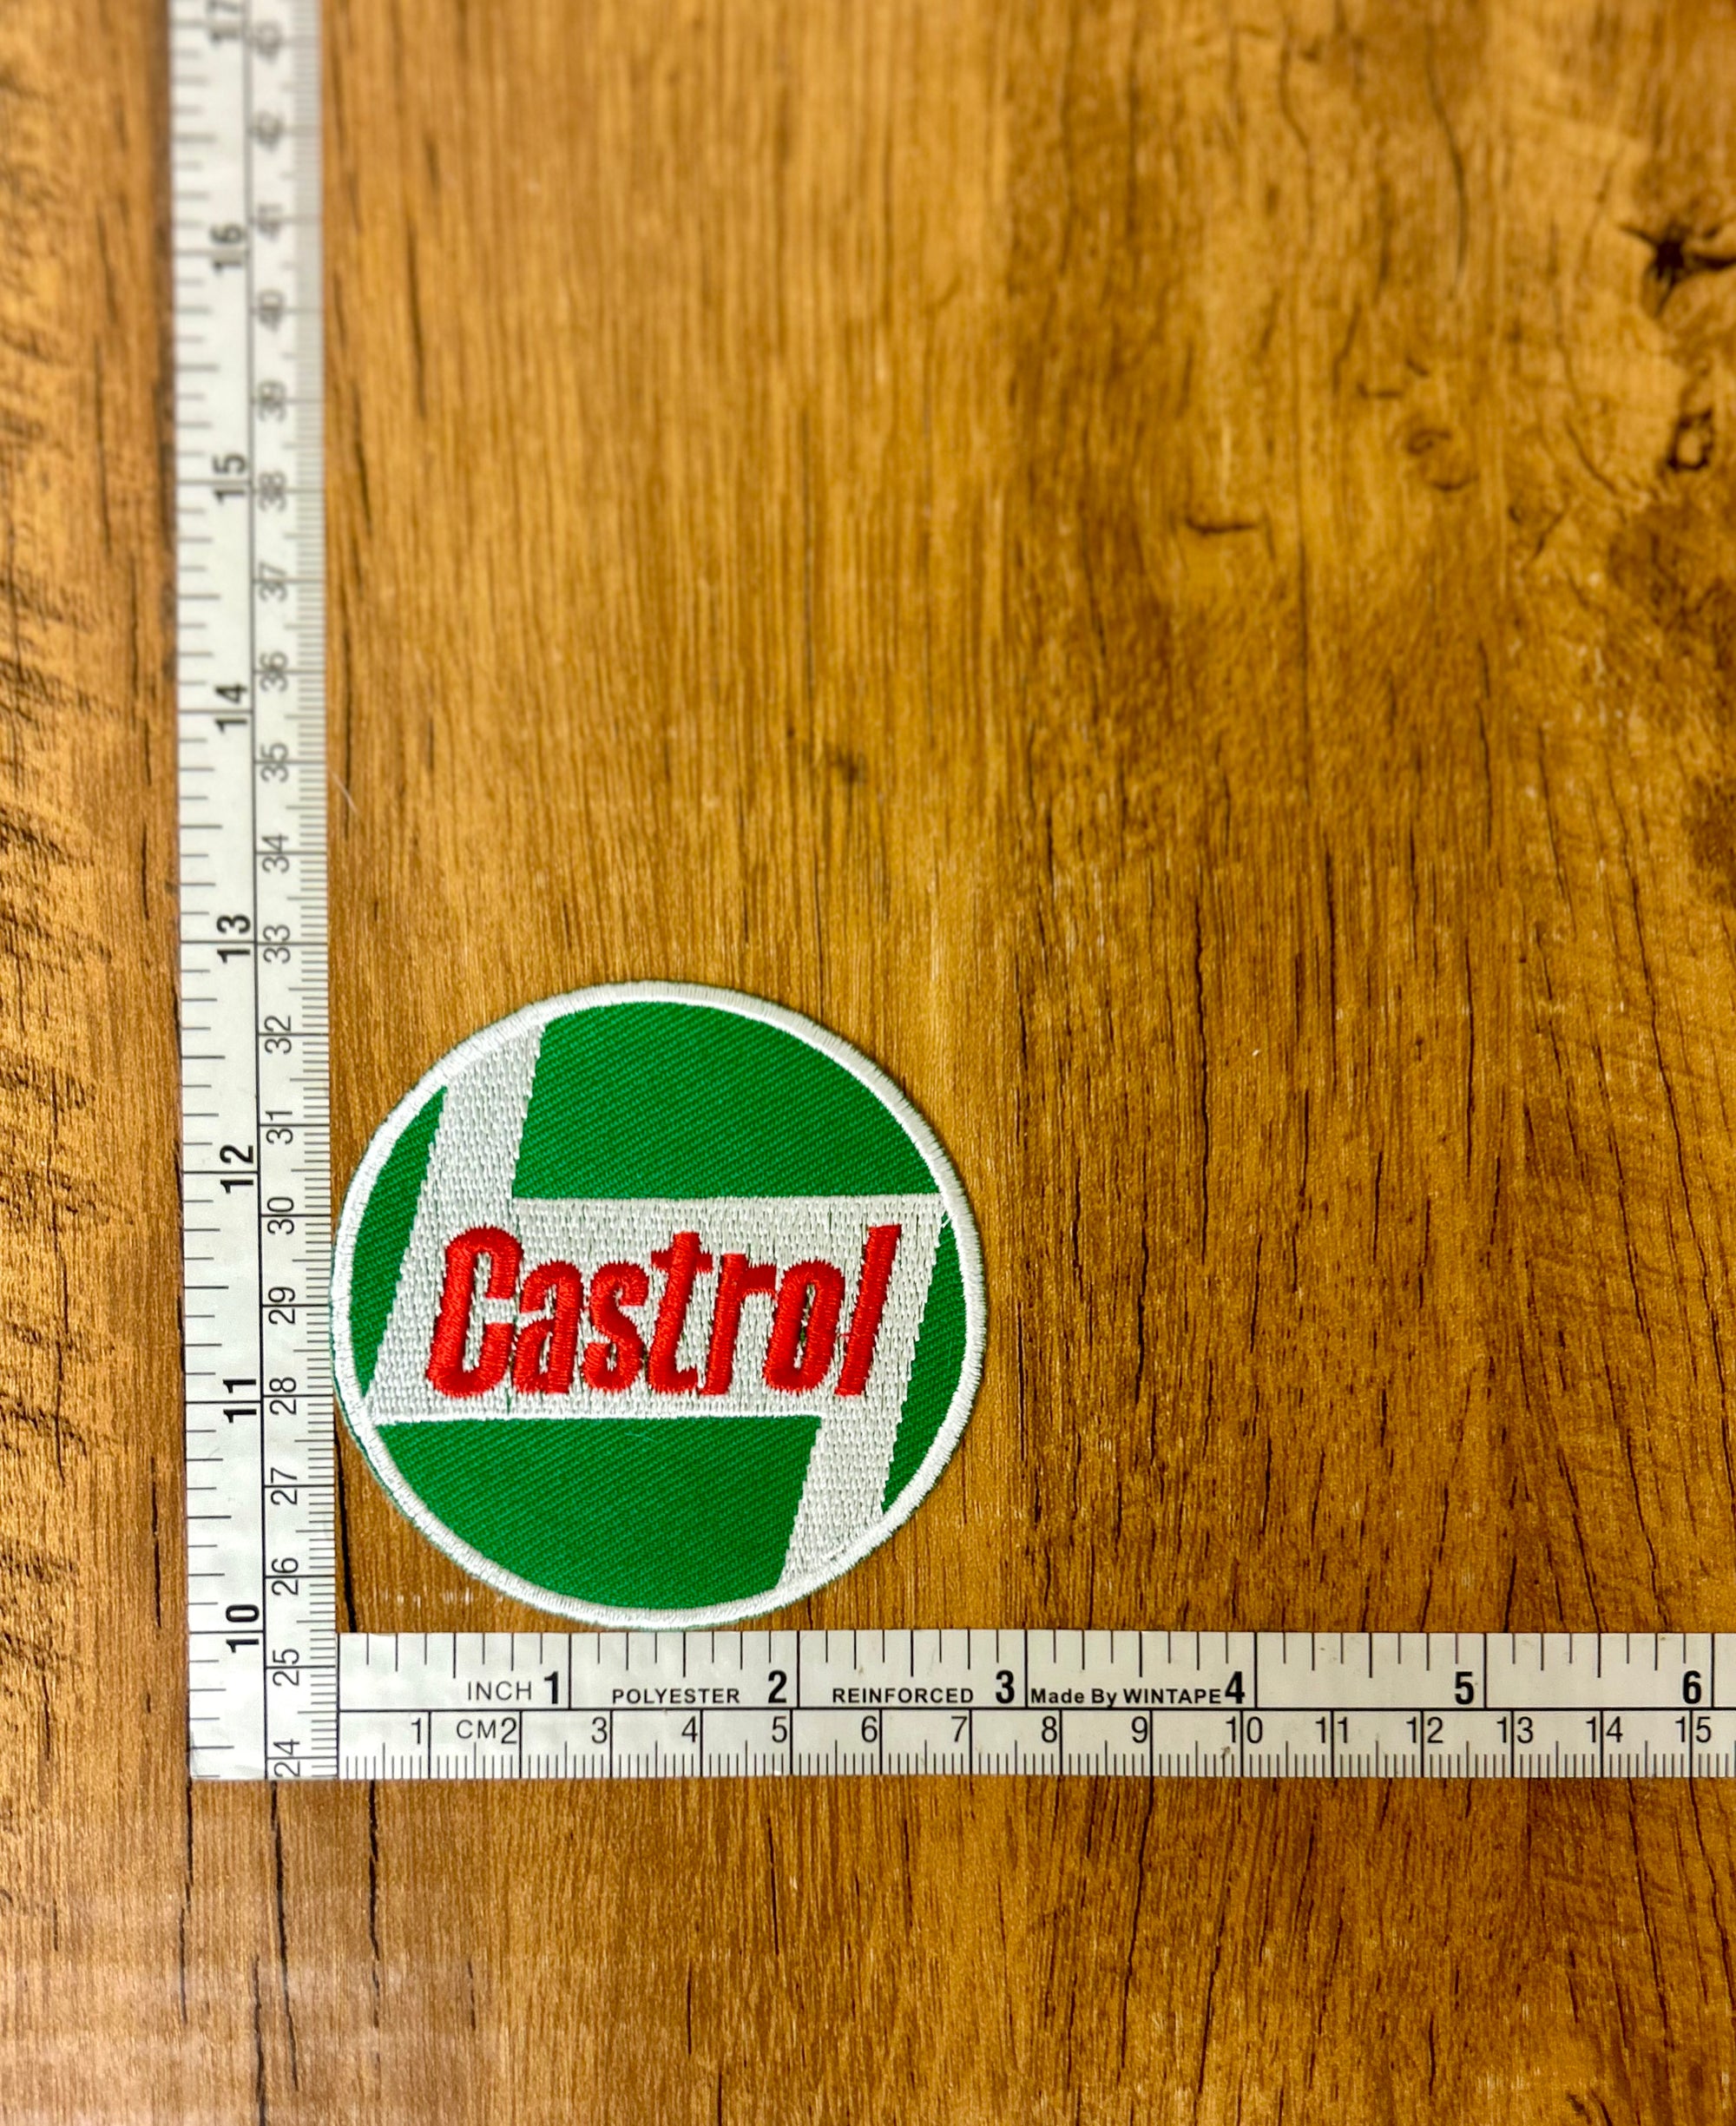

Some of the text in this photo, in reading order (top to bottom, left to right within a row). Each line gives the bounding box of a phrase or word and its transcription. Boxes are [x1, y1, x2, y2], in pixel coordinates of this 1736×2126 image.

[209, 223, 246, 274] 16
[258, 380, 287, 423] 39
[213, 453, 247, 505] 15
[258, 470, 287, 513] 38
[260, 563, 288, 602] 37
[260, 650, 288, 693] 36
[214, 682, 247, 734] 14
[261, 741, 288, 782] 35
[262, 833, 289, 873] 34
[216, 913, 251, 964] 13
[263, 924, 291, 964] 33
[264, 1015, 292, 1055] 32
[266, 1110, 293, 1144] 31
[220, 1144, 253, 1195] 12
[267, 1196, 294, 1234] 30
[268, 1286, 296, 1326] 29
[425, 1224, 902, 1399] Castrol
[222, 1378, 257, 1424] 11
[269, 1376, 297, 1416] 28
[271, 1466, 298, 1506] 27
[272, 1557, 299, 1596] 26
[225, 1603, 260, 1654] 10
[273, 1649, 299, 1687] 25
[466, 1681, 533, 1701] INCH
[544, 1671, 559, 1705] 1
[612, 1688, 740, 1704] POLYESTER
[768, 1669, 787, 1704] 2
[832, 1688, 974, 1703] REINFORCED
[996, 1669, 1015, 1704] 3
[1030, 1688, 1221, 1708] Made By WINTAPE
[1225, 1671, 1246, 1704] 4
[1455, 1671, 1475, 1705] 5
[1682, 1670, 1701, 1704] 6
[411, 1718, 422, 1745] 1
[457, 1719, 496, 1739] CM
[501, 1717, 517, 1744] 2
[591, 1717, 608, 1744] 3
[681, 1716, 698, 1743] 4
[772, 1715, 787, 1743] 5
[861, 1715, 878, 1743] 6
[951, 1716, 968, 1743] 7
[1042, 1716, 1057, 1743] 8
[1131, 1716, 1147, 1743] 9
[1226, 1716, 1263, 1744] 10
[1315, 1716, 1348, 1744] 11
[1406, 1716, 1443, 1744] 12
[1496, 1716, 1534, 1744] 13
[1586, 1716, 1623, 1743] 14
[1675, 1716, 1712, 1744] 15
[273, 1738, 300, 1778] 24
